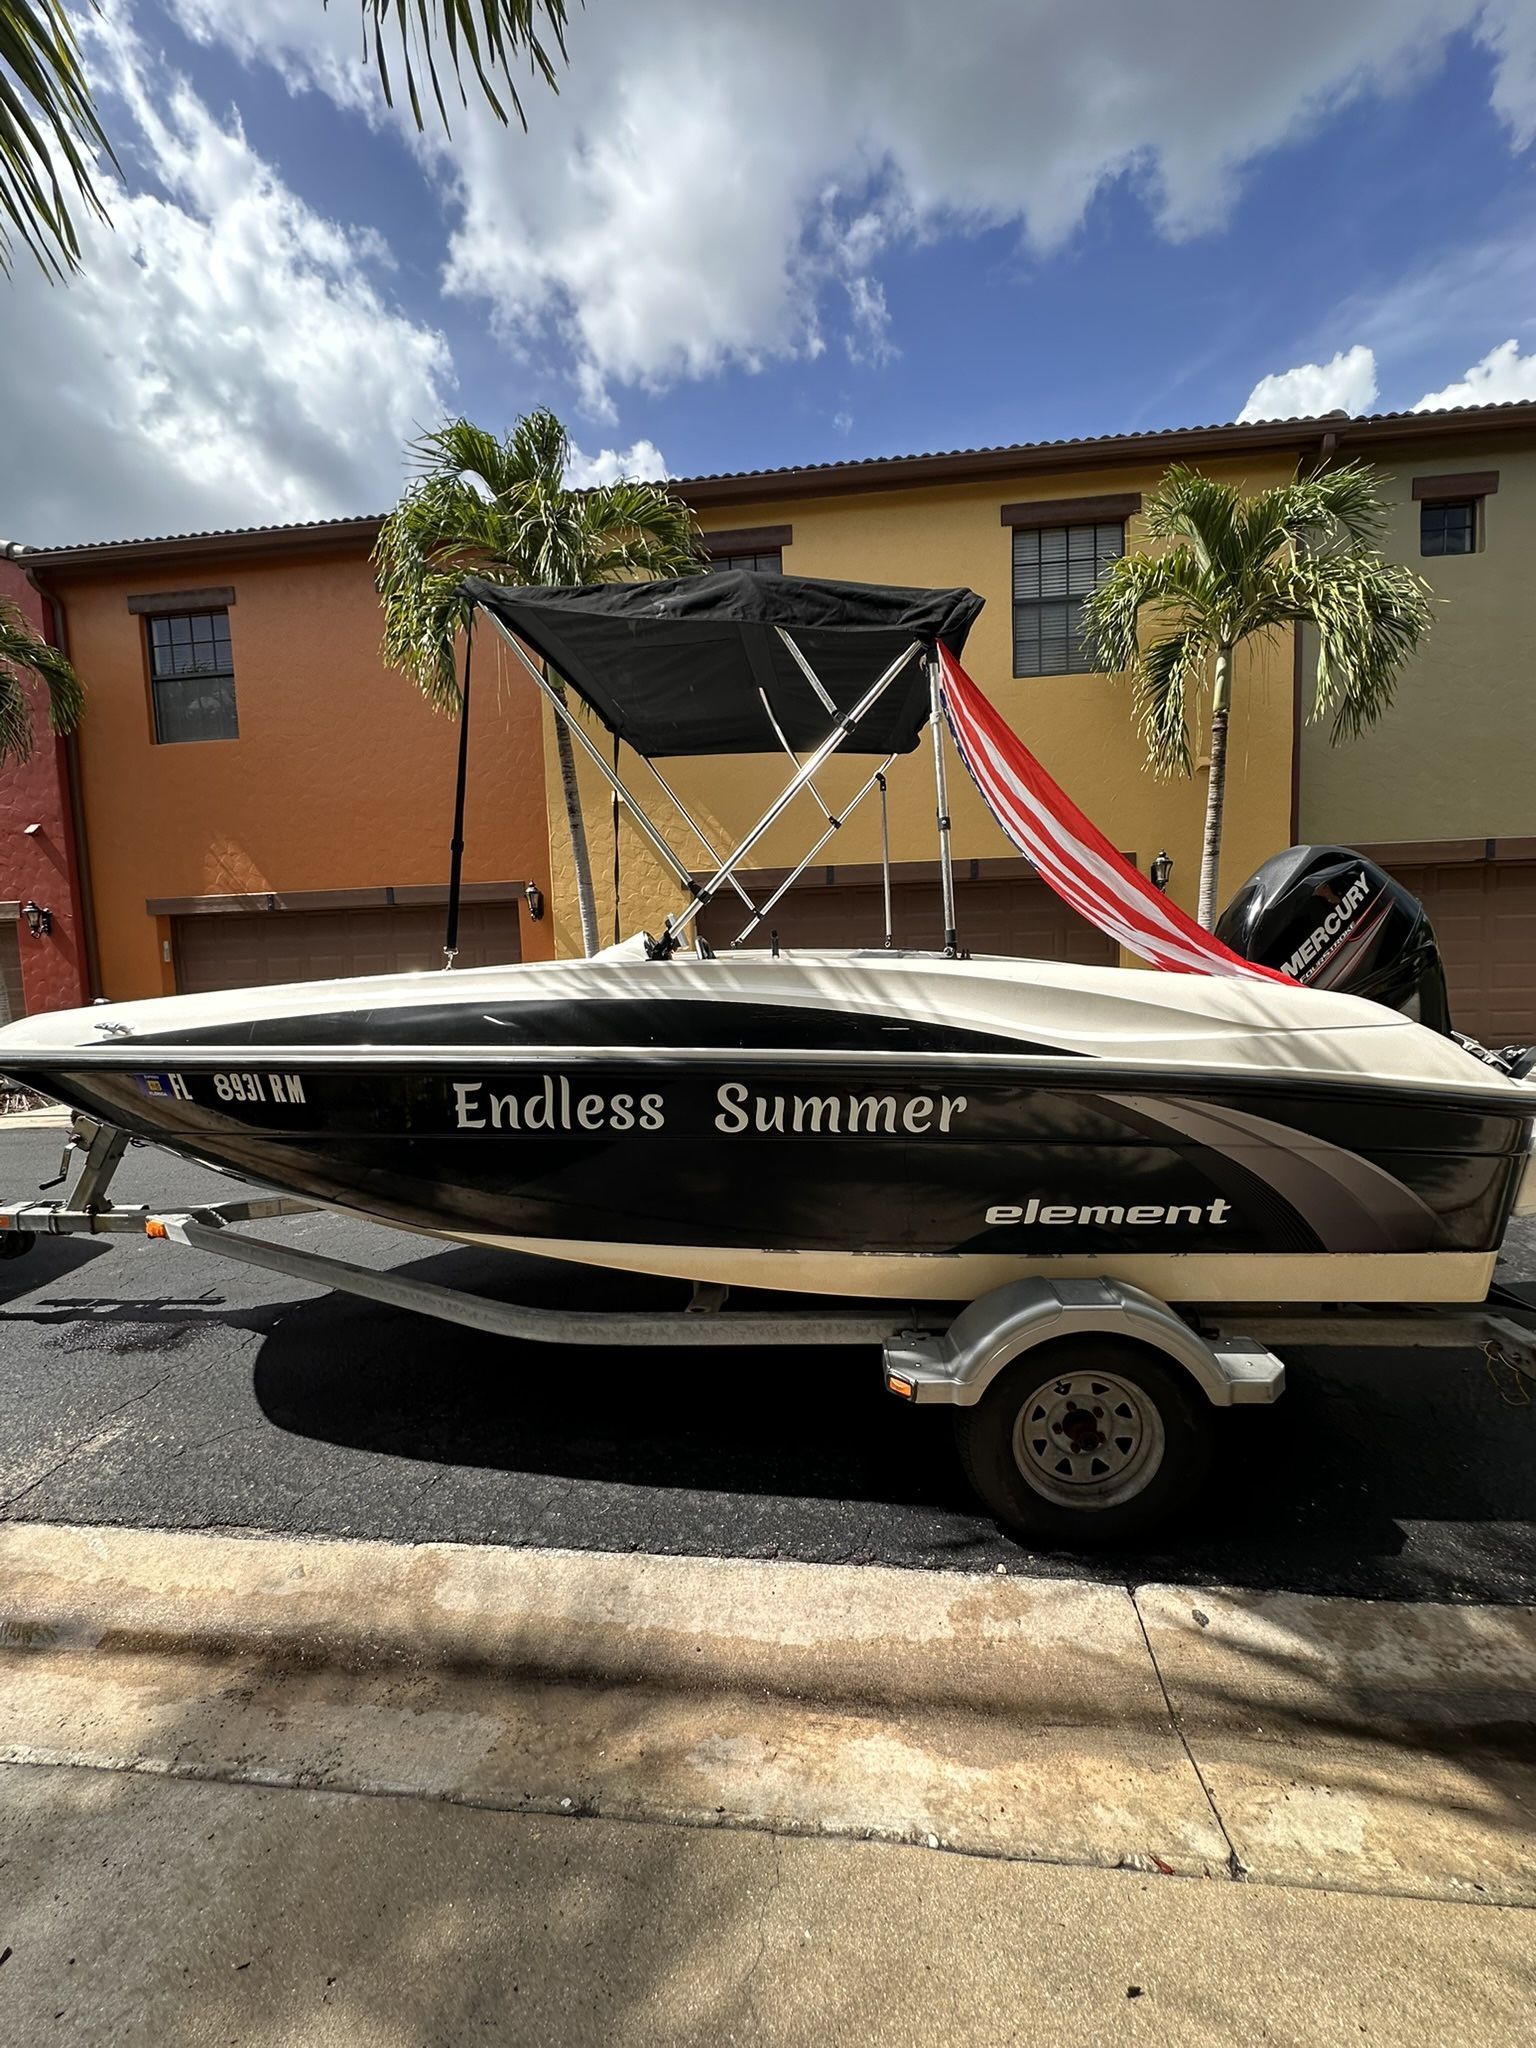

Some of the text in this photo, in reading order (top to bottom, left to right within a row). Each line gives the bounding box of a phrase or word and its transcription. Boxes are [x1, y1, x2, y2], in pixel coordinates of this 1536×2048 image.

[1280, 872, 1370, 976] MERCURY
[168, 1073, 306, 1103] FL 8931 RM
[453, 1075, 968, 1133] Endless Summer
[985, 1198, 1232, 1225] element
